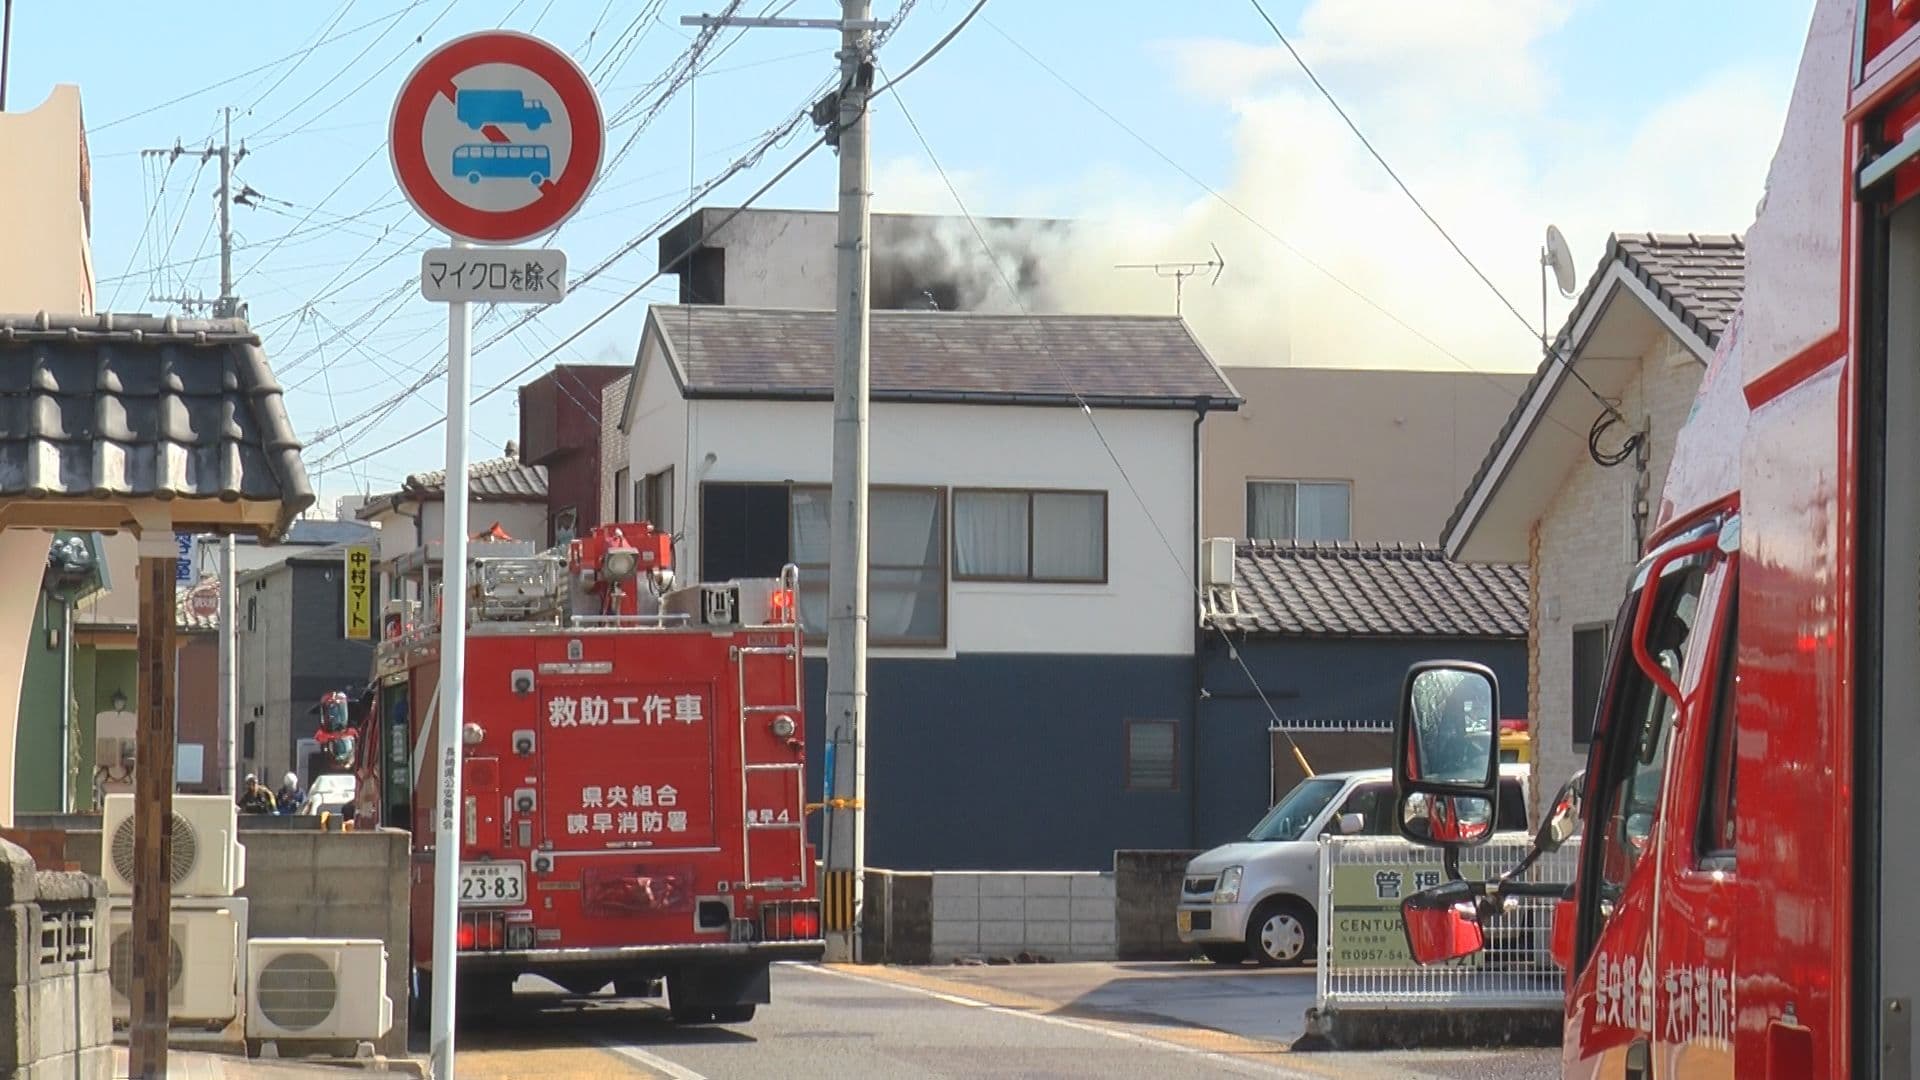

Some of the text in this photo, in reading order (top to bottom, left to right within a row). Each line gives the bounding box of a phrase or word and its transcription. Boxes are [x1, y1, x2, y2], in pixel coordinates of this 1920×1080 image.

[429, 261, 560, 292] マイクロを除く
[350, 551, 367, 629] 中村マート
[548, 694, 704, 728] 救助工作車
[582, 784, 678, 808] 県央組合
[1664, 960, 1736, 1052] 大村消防
